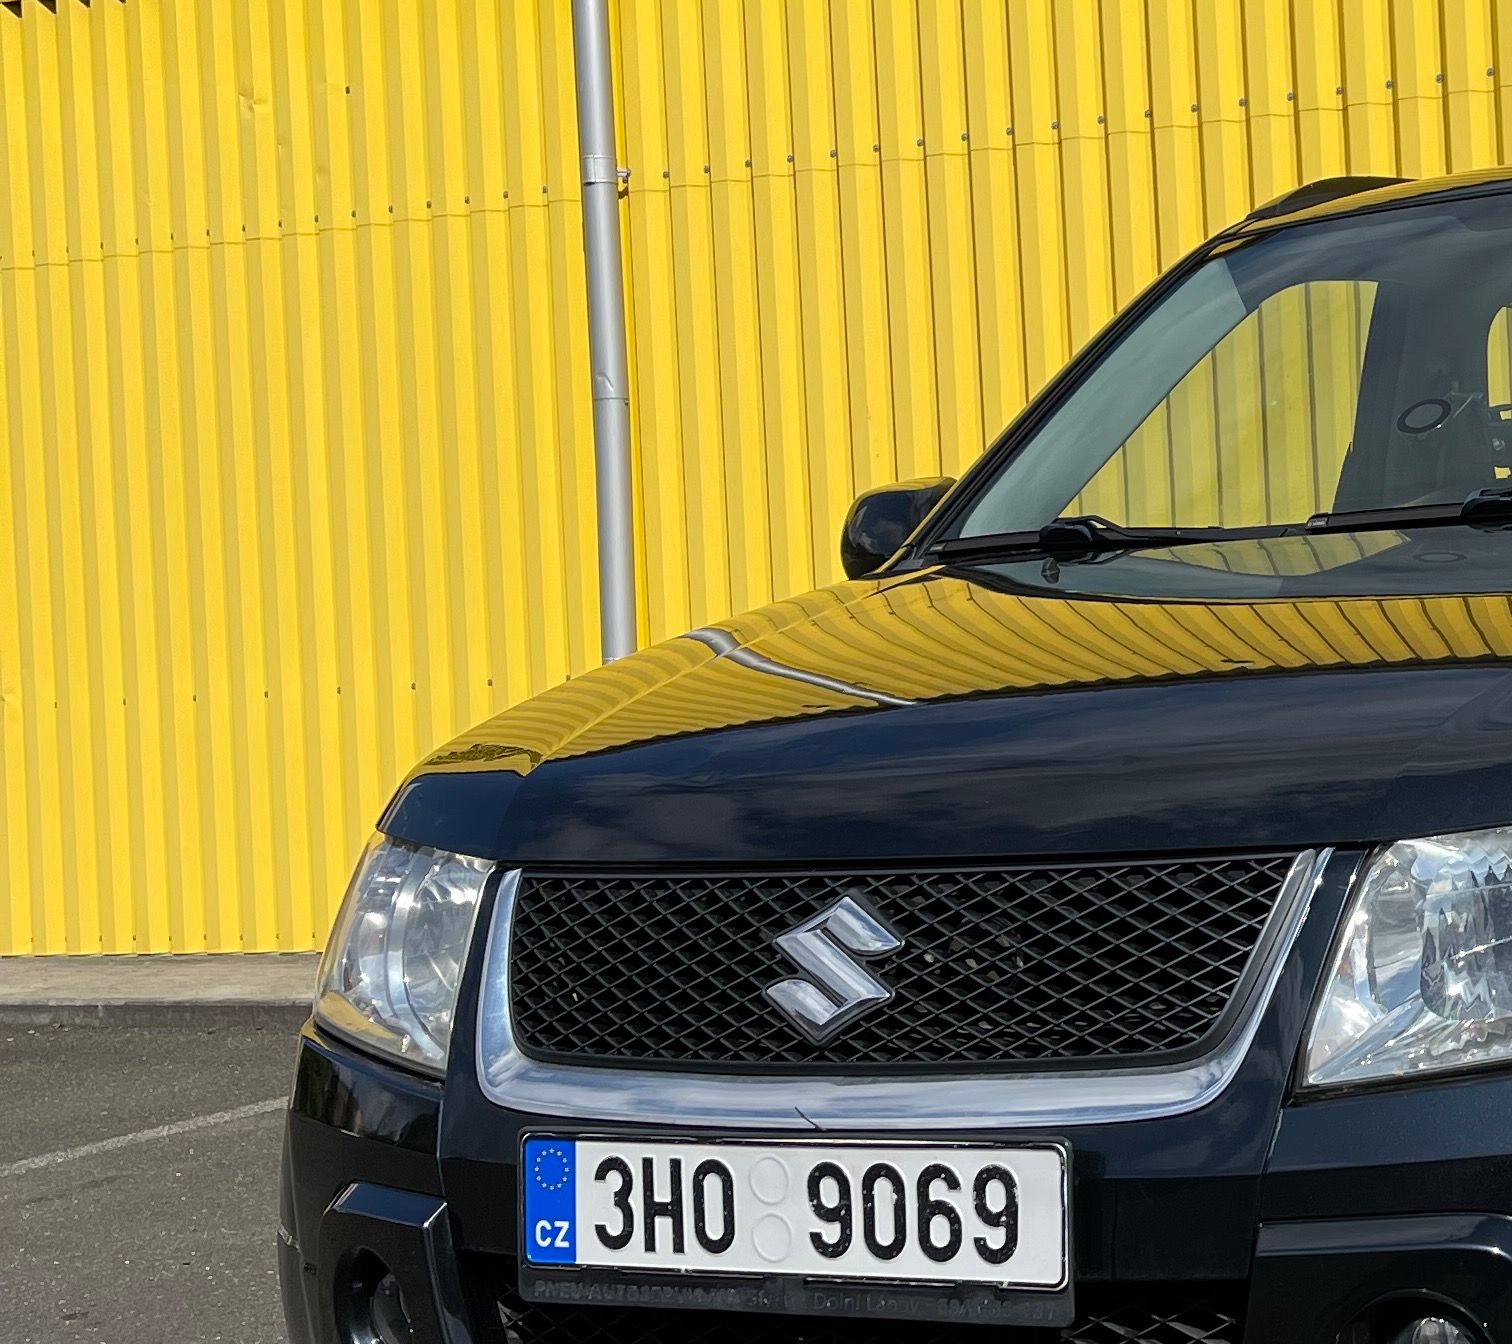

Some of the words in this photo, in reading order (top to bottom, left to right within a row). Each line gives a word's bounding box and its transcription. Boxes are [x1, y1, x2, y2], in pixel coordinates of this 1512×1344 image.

[535, 1219, 570, 1249] CZ
[594, 1155, 735, 1254] 3H0
[807, 1160, 1020, 1265] 9069
